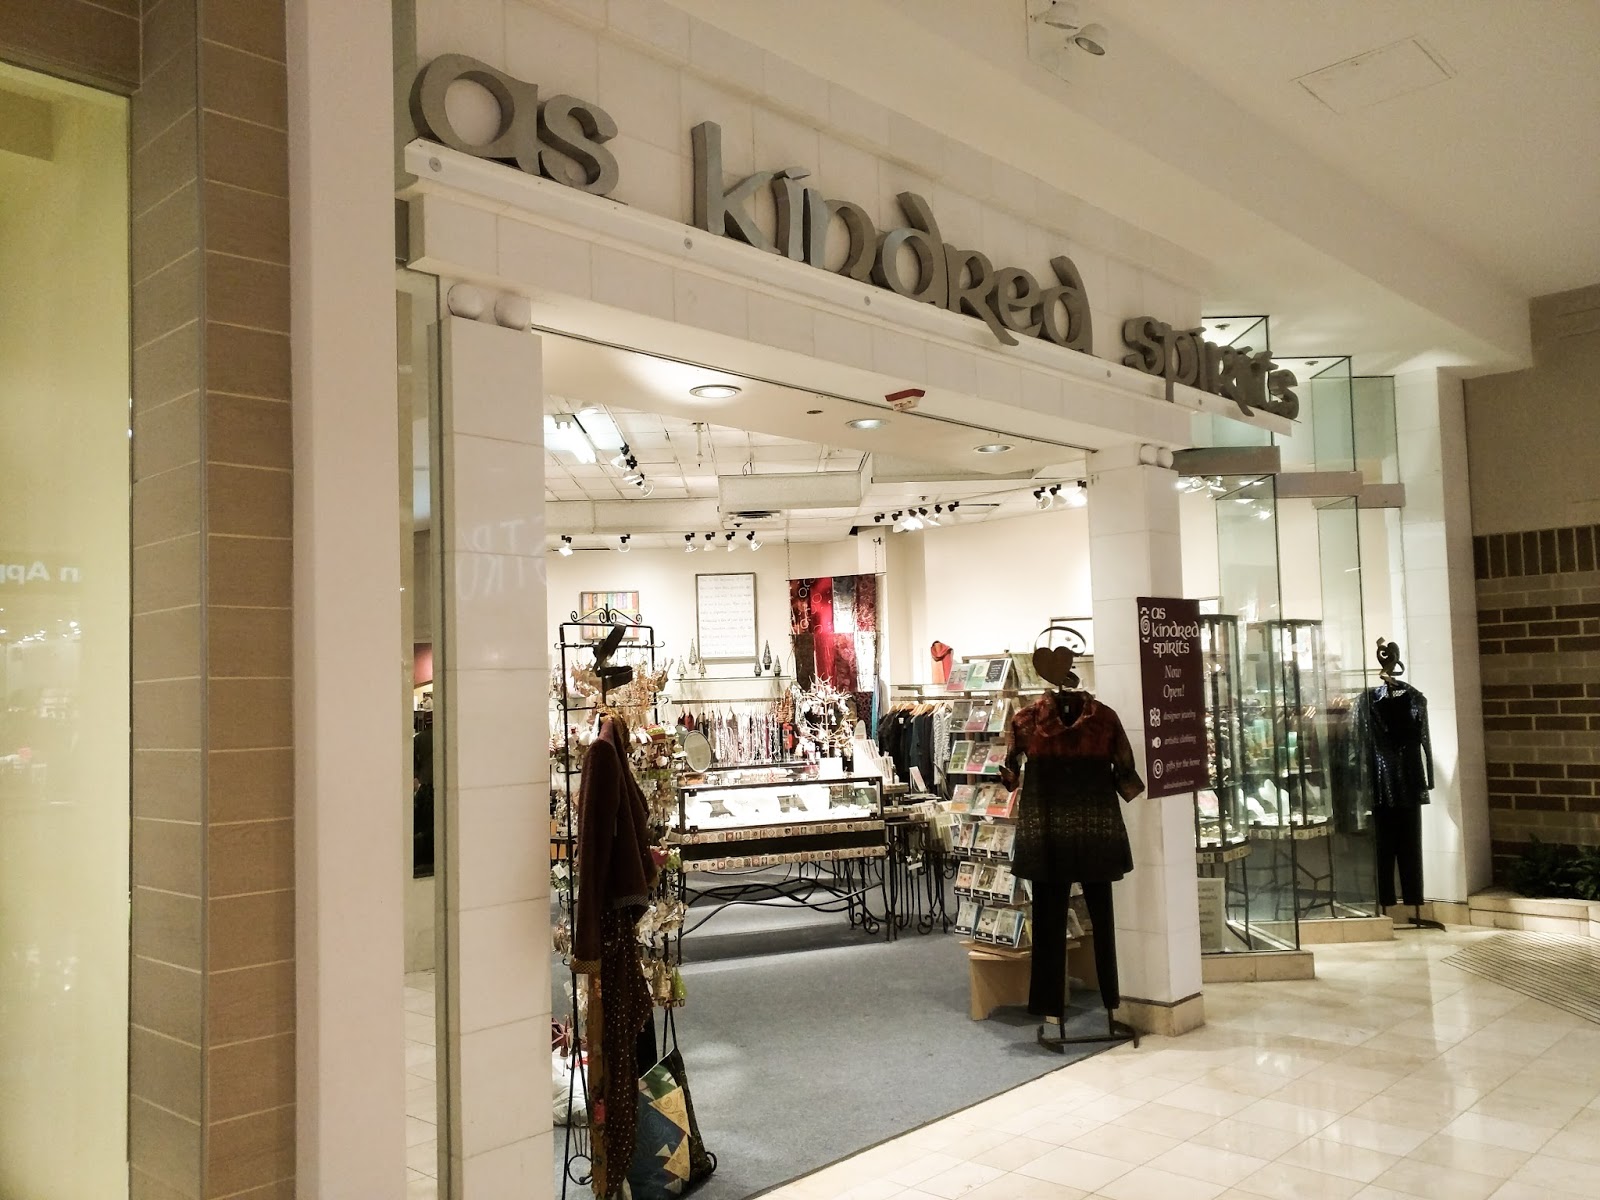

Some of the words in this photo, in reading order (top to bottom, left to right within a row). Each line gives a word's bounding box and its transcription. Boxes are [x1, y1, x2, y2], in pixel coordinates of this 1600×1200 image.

[409, 53, 620, 195] as
[692, 120, 1092, 354] kindred
[1151, 607, 1166, 620] as
[1151, 620, 1199, 640] kindred
[1152, 640, 1190, 658] spirits
[1164, 664, 1182, 678] Now
[1163, 684, 1185, 702] Open!
